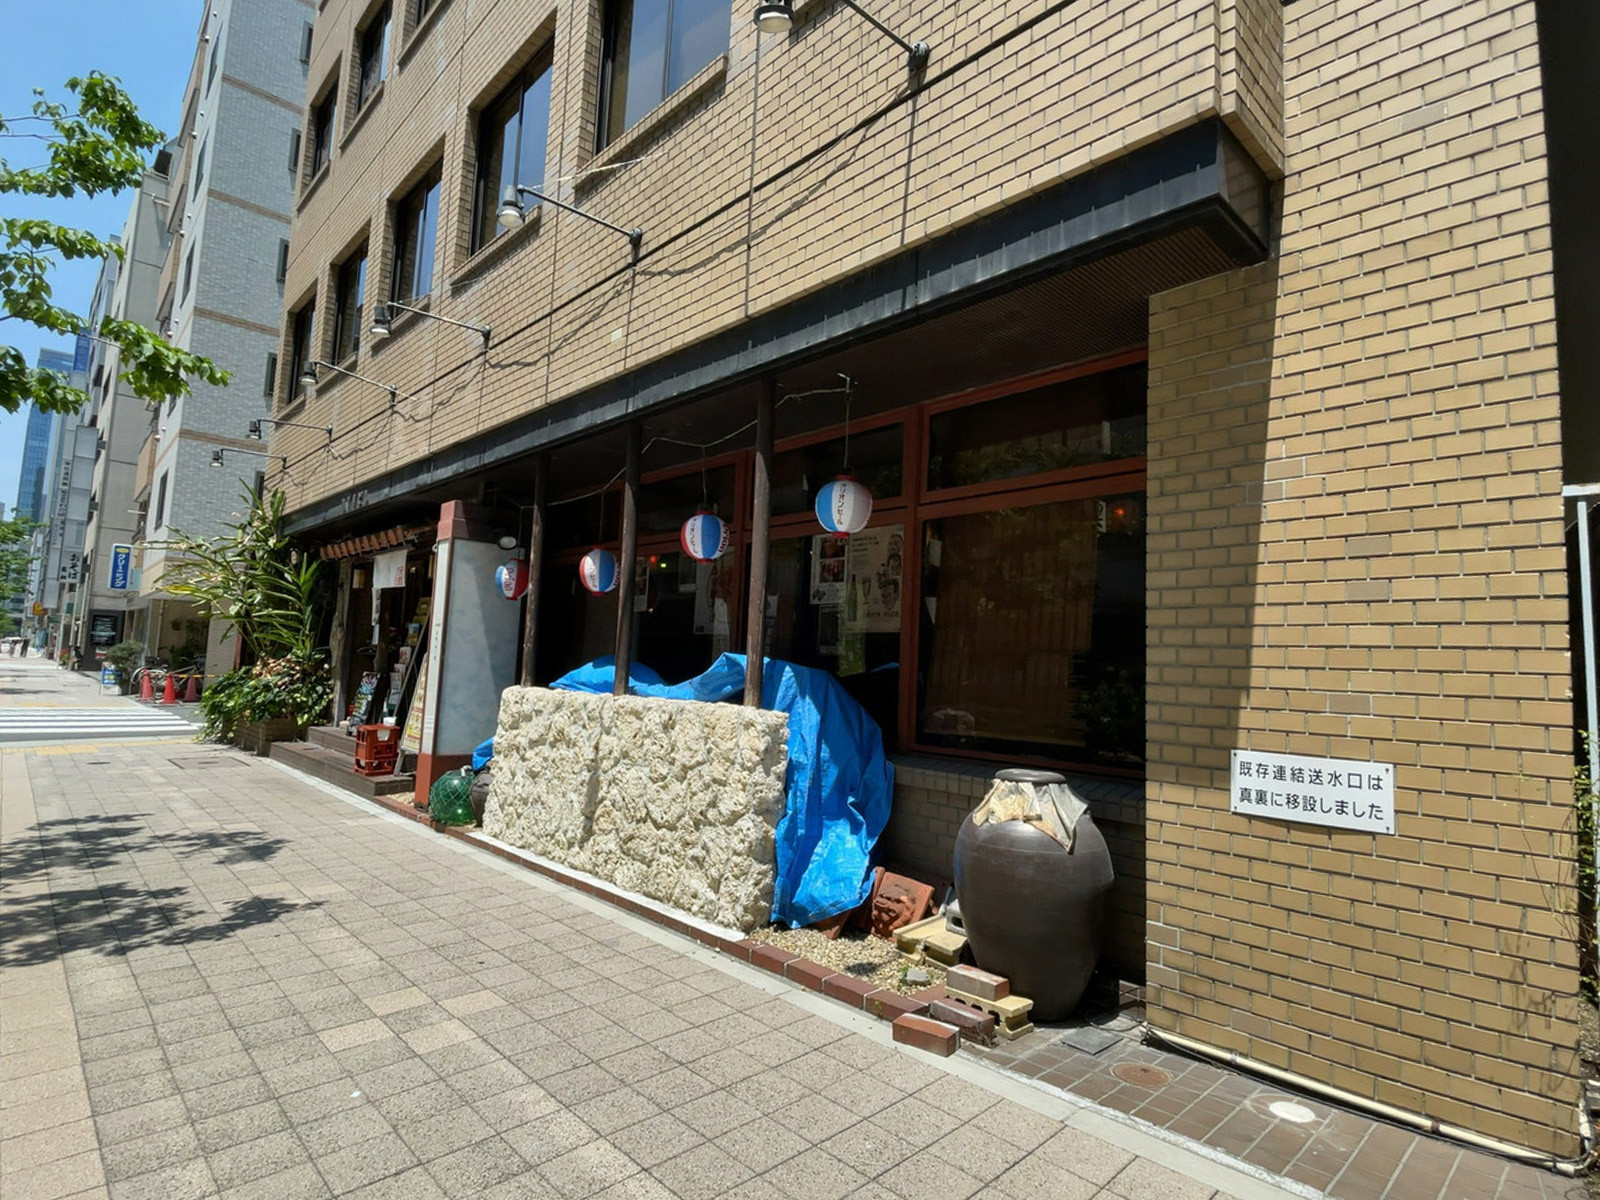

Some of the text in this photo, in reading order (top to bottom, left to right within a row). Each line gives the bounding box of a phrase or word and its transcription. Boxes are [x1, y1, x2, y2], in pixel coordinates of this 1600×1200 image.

[68, 553, 80, 580] おそば
[114, 553, 126, 588] クリーニング
[1239, 761, 1383, 791] 既存連結送水口は
[1239, 787, 1384, 821] 真裏に移設しました
